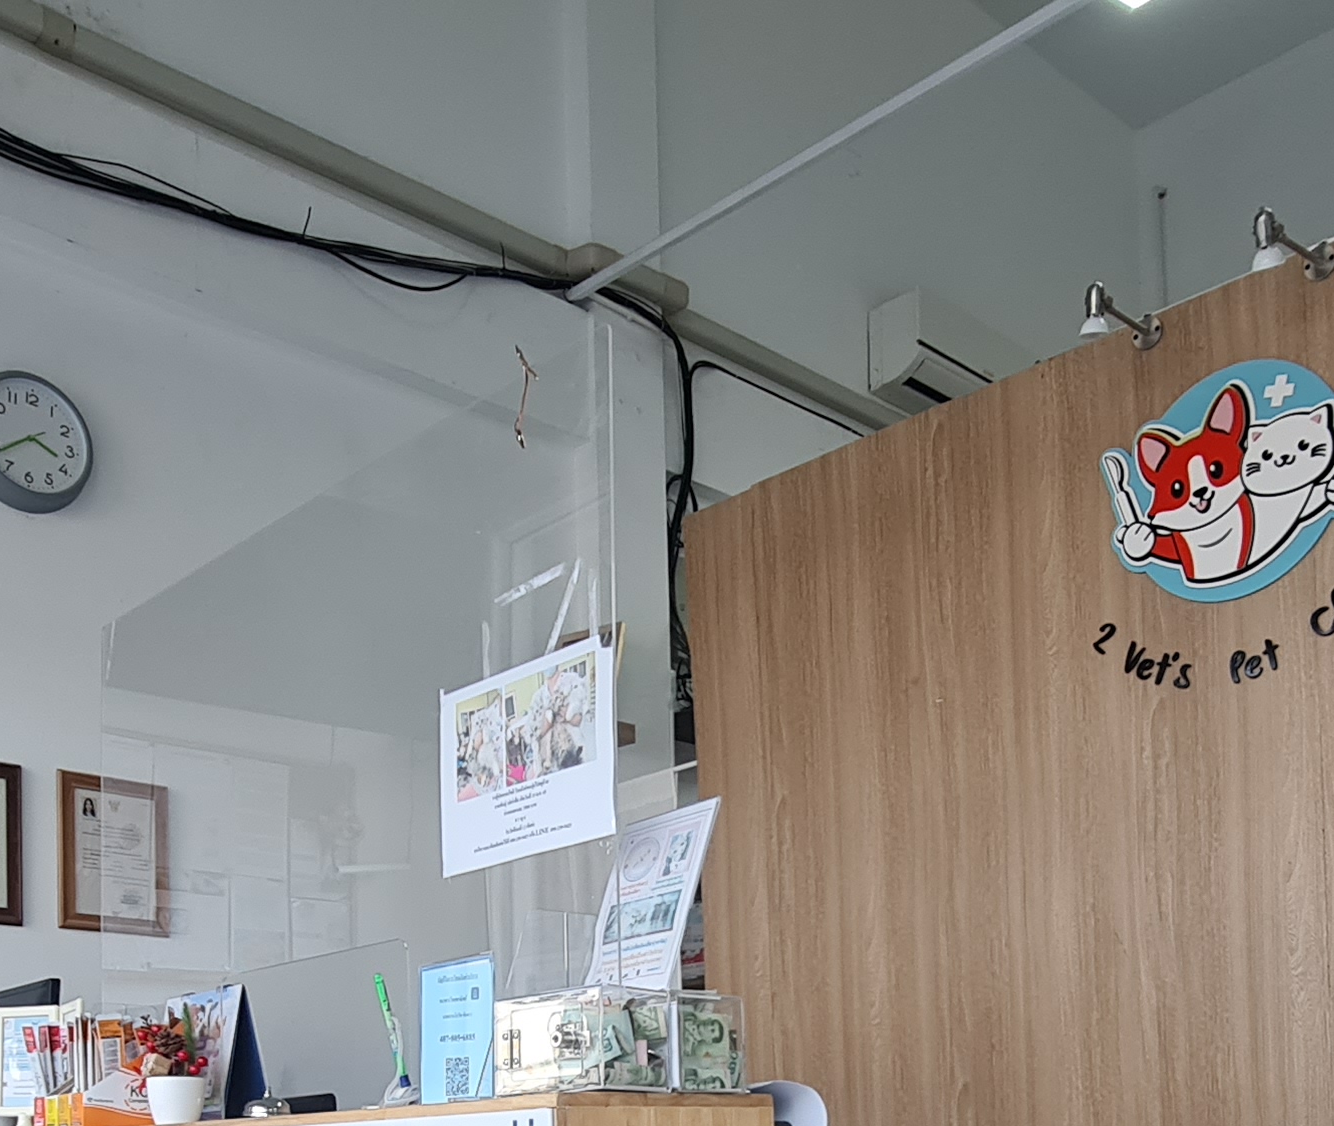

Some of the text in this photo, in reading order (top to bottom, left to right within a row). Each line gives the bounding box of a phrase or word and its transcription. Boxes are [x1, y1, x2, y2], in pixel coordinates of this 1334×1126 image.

[8, 390, 17, 404] 11
[25, 391, 39, 407] 12
[59, 425, 70, 438] 2
[64, 445, 75, 459] 3
[4, 459, 14, 471] 7
[58, 464, 68, 476] 4
[24, 471, 34, 484] 6
[44, 473, 54, 485] 5
[1093, 622, 1117, 655] 2
[1124, 641, 1192, 689] Vet's
